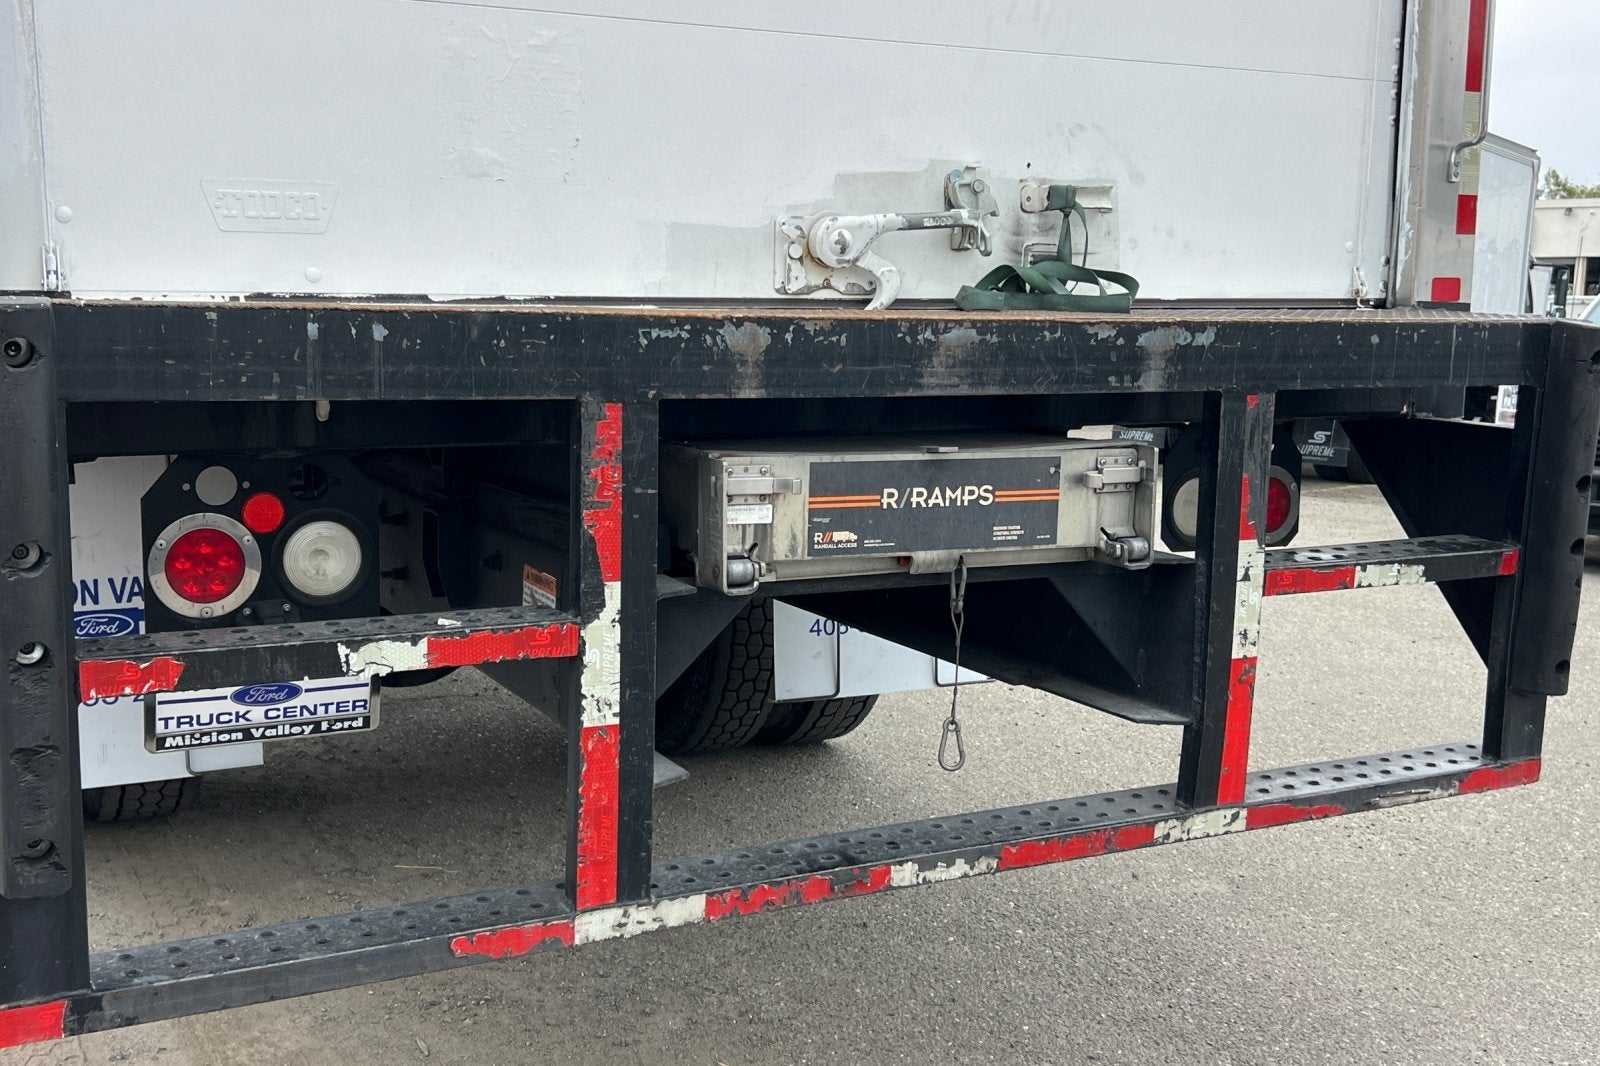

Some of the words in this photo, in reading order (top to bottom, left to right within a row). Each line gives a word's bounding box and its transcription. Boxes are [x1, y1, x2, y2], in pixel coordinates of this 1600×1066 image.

[1118, 429, 1155, 442] SUPREME
[881, 485, 994, 509] R/RAMPS
[76, 618, 119, 635] Ford
[602, 631, 615, 683] SUPREME
[245, 685, 288, 702] Ford
[158, 709, 252, 730] TRUCK
[264, 699, 369, 720] CENTER
[250, 724, 315, 740] Valley
